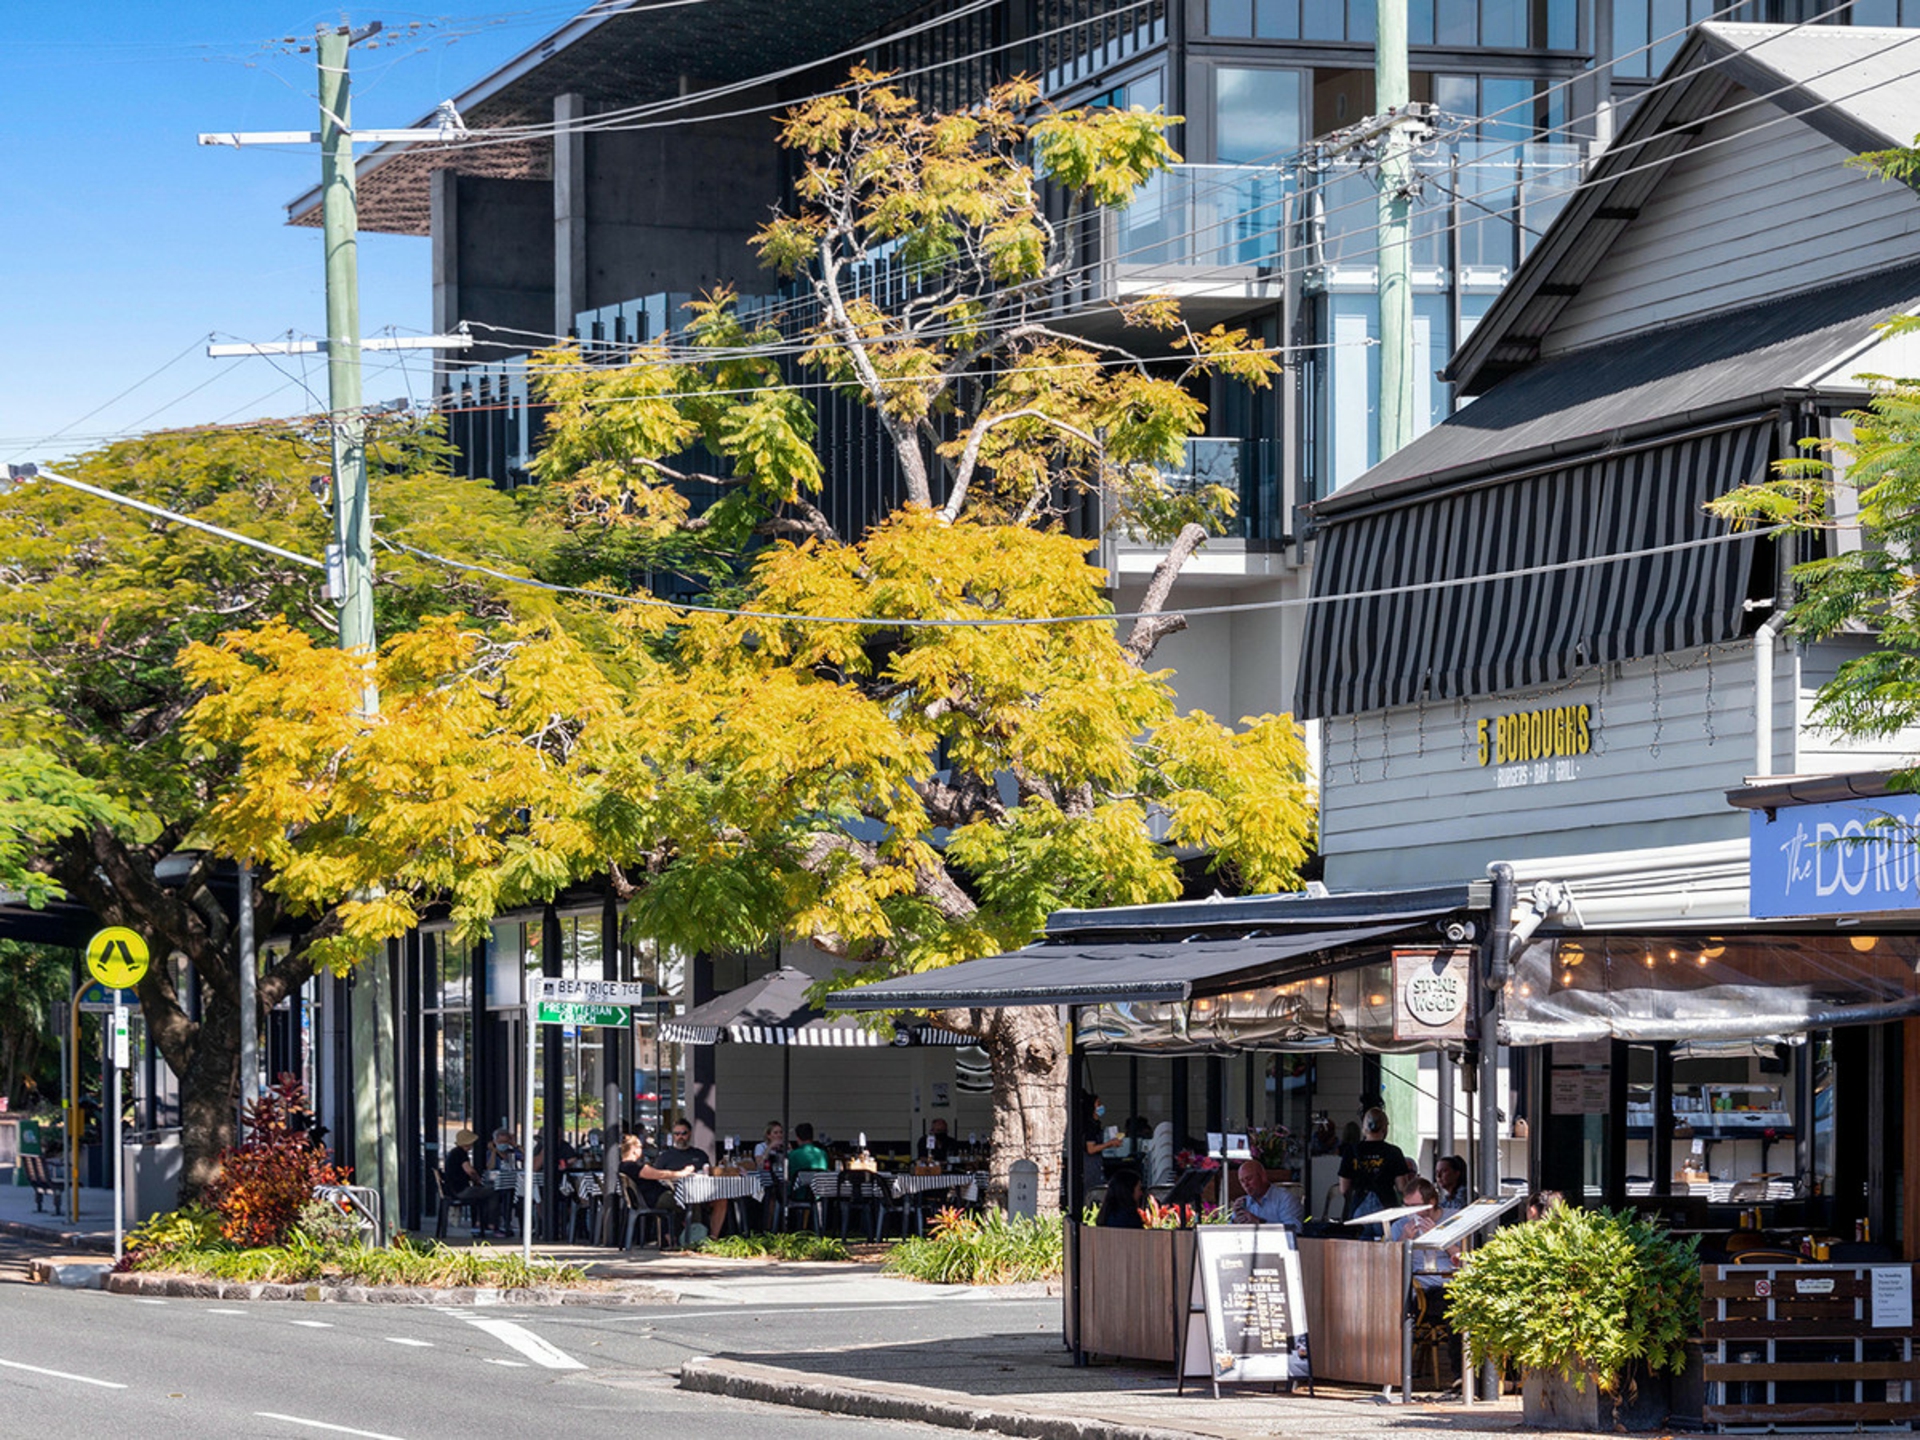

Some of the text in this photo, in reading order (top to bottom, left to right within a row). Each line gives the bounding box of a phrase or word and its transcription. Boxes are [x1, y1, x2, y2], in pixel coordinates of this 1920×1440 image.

[1477, 703, 1590, 767] 5 BOROUGHS
[1780, 822, 1813, 897] The
[559, 980, 640, 996] BEATRICE TCE
[1413, 978, 1457, 995] STONE
[543, 1002, 612, 1015] PRESBYTERIAN
[1413, 996, 1456, 1012] WOOD
[558, 1012, 597, 1024] CHURCH
